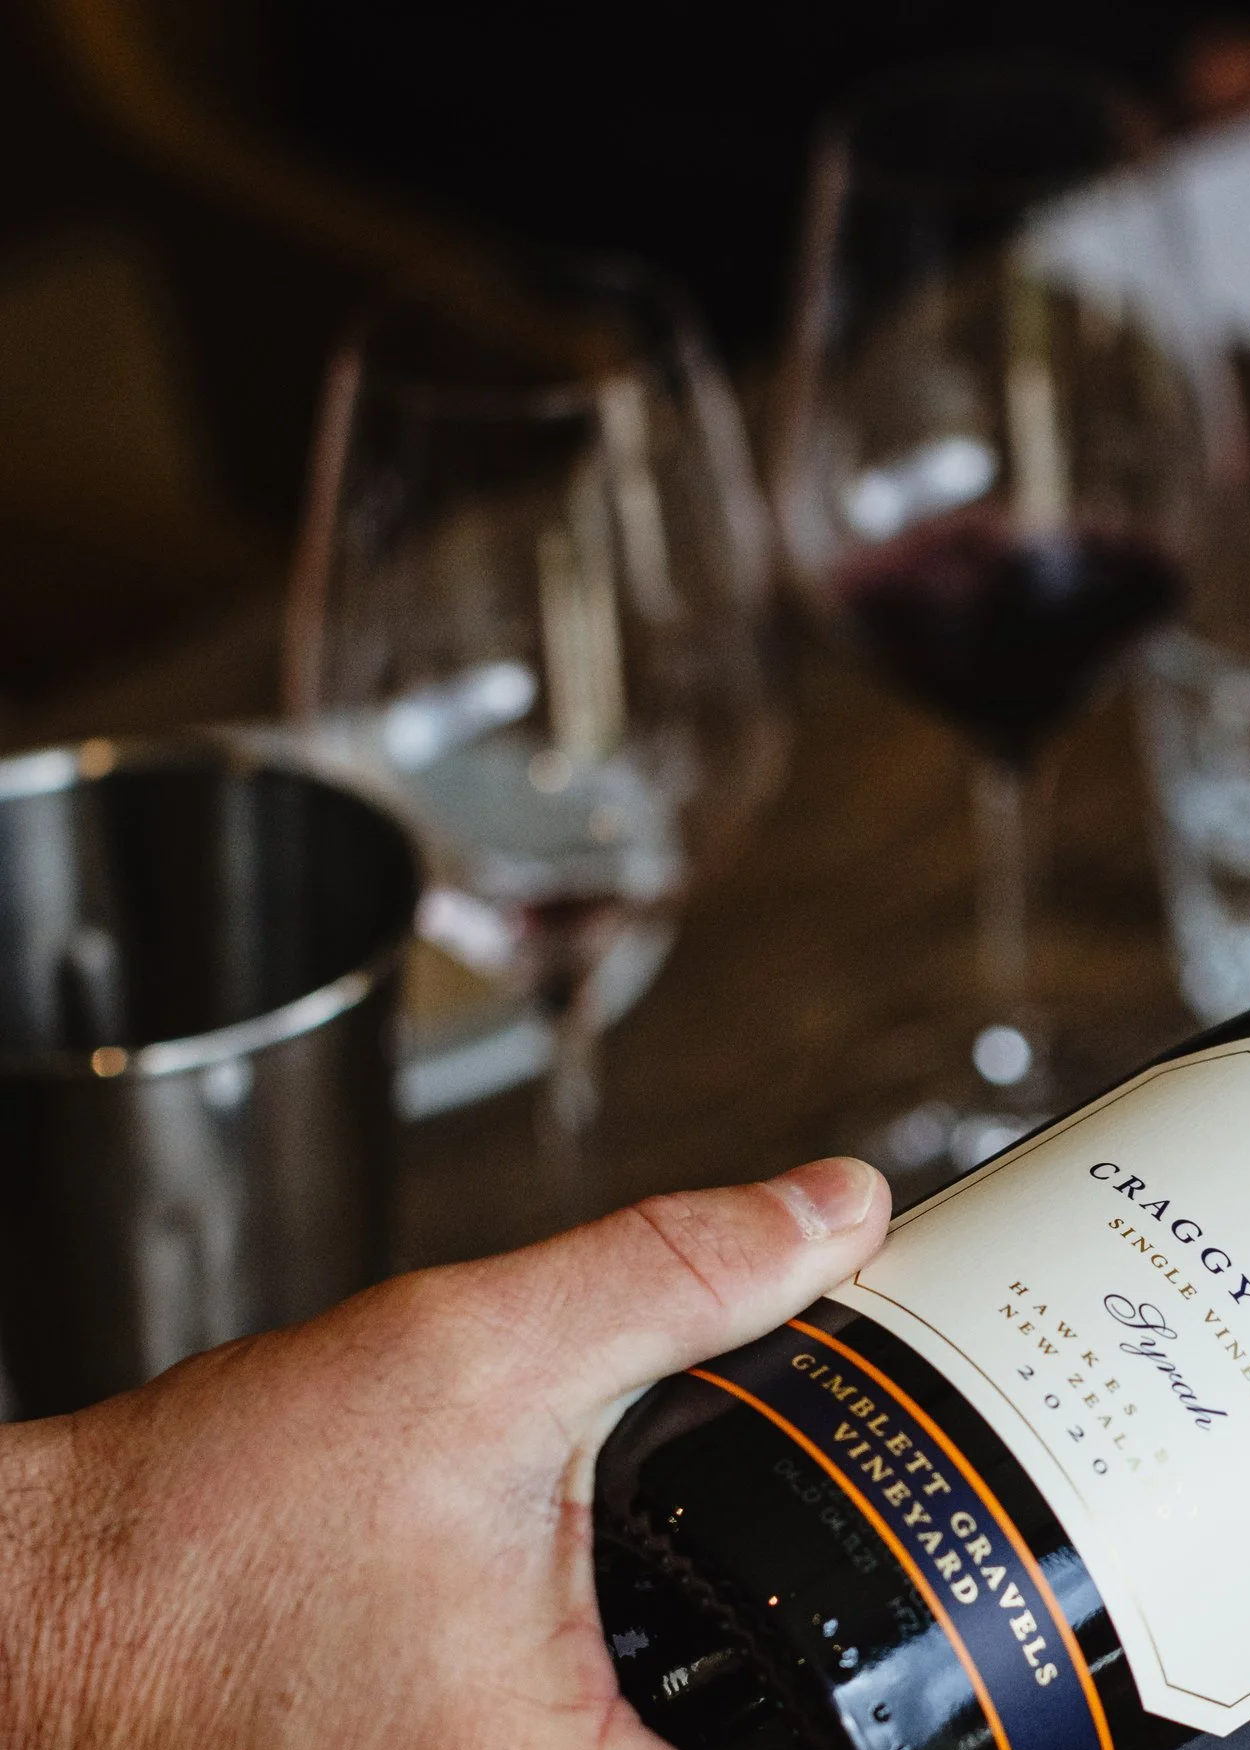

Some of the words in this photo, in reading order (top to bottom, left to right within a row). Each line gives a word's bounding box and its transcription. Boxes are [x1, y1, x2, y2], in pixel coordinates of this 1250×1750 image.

[1108, 1217, 1198, 1300] SINGLE
[998, 1304, 1059, 1356] NEW
[1009, 1281, 1138, 1416] HAWKES
[1104, 1294, 1228, 1431] Syrah
[1017, 1365, 1108, 1475] 2020
[791, 1354, 951, 1496] GIMBLETT
[951, 1511, 1058, 1686] GRAVELS
[834, 1422, 978, 1604] VINEYARD
